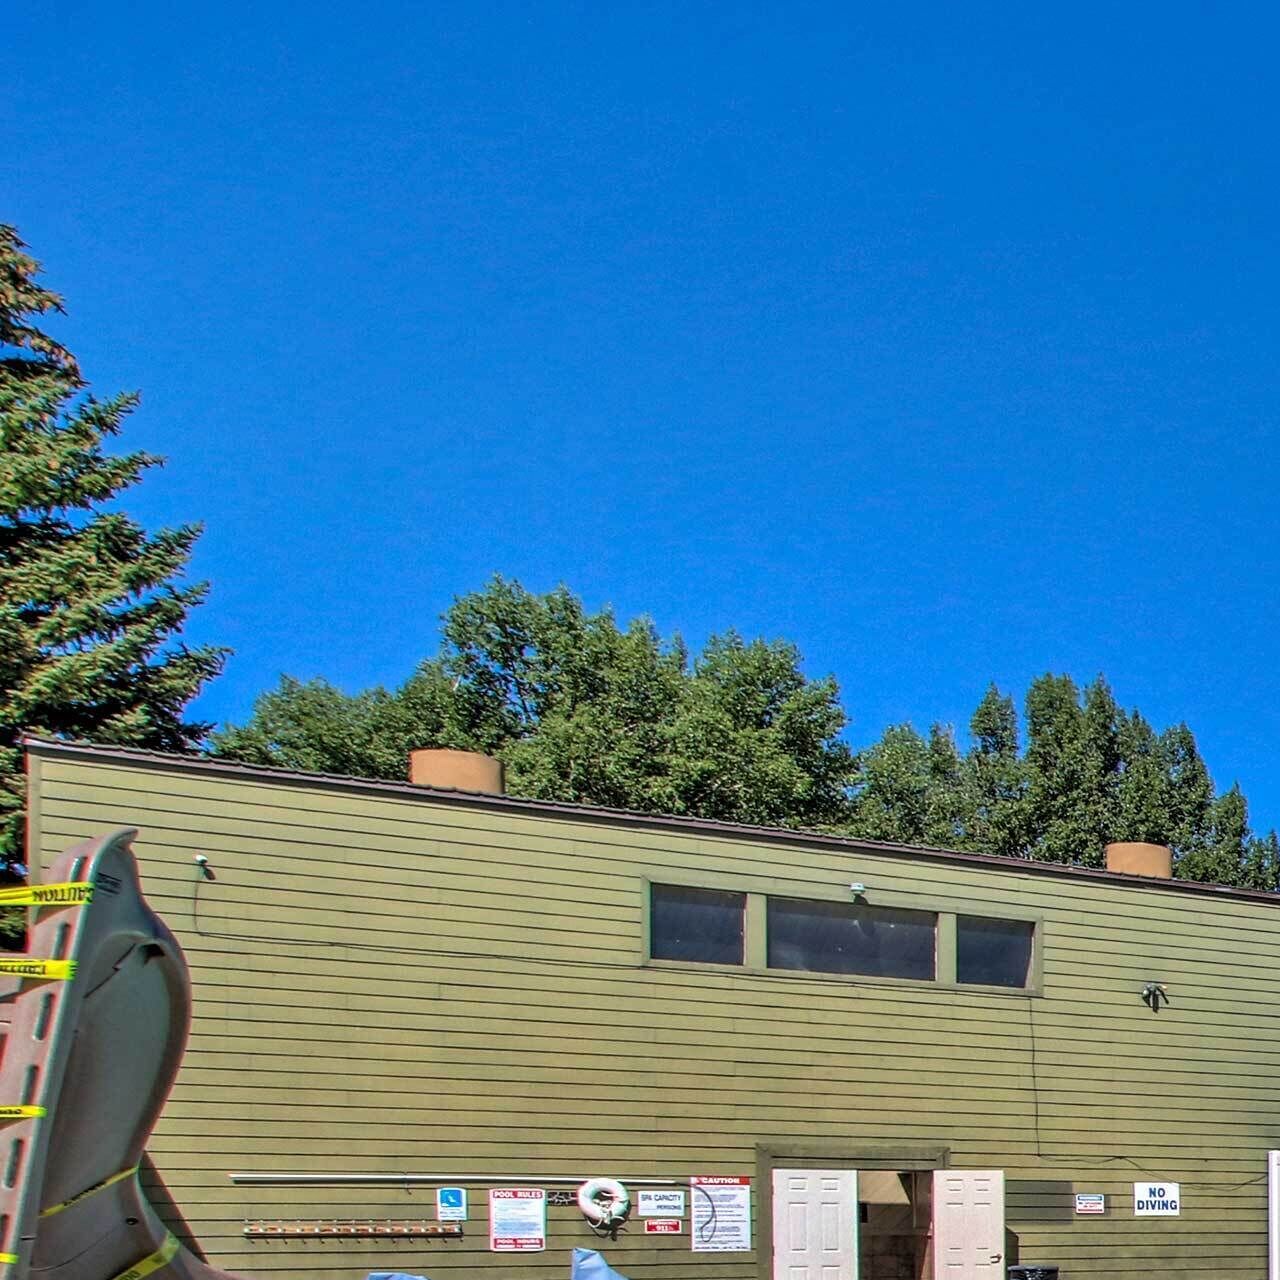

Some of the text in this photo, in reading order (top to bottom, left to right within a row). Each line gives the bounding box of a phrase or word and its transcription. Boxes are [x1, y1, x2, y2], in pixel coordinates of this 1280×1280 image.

[494, 1190, 542, 1198] POOL RULES
[1148, 1187, 1166, 1198] NO
[1137, 1200, 1178, 1211] DIVING
